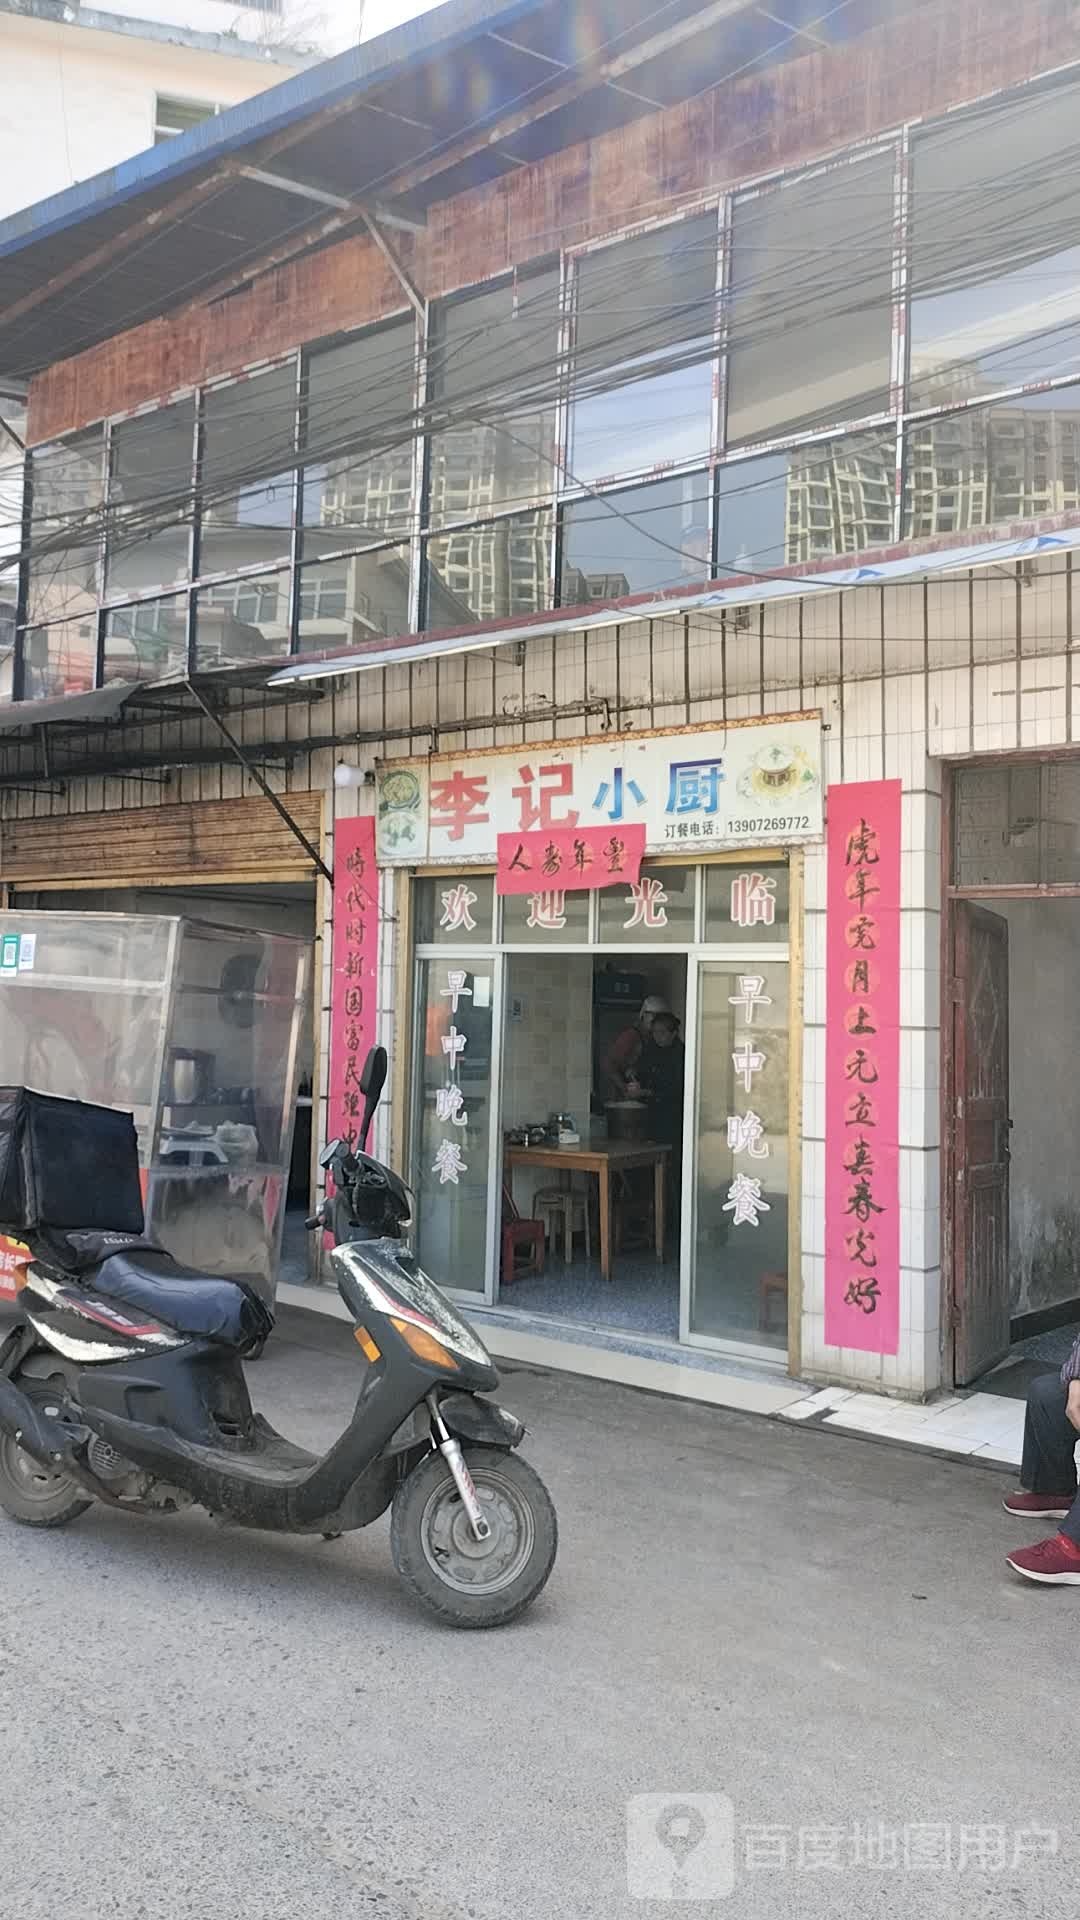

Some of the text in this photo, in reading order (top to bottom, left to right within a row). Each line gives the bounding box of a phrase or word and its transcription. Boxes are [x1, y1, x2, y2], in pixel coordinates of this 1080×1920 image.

[430, 757, 726, 841] 李记小厨
[727, 816, 809, 833] 13907269772
[440, 872, 777, 931] 欢迎光临
[432, 970, 474, 1184] 早中晚餐
[722, 975, 771, 1226] 早中晚餐
